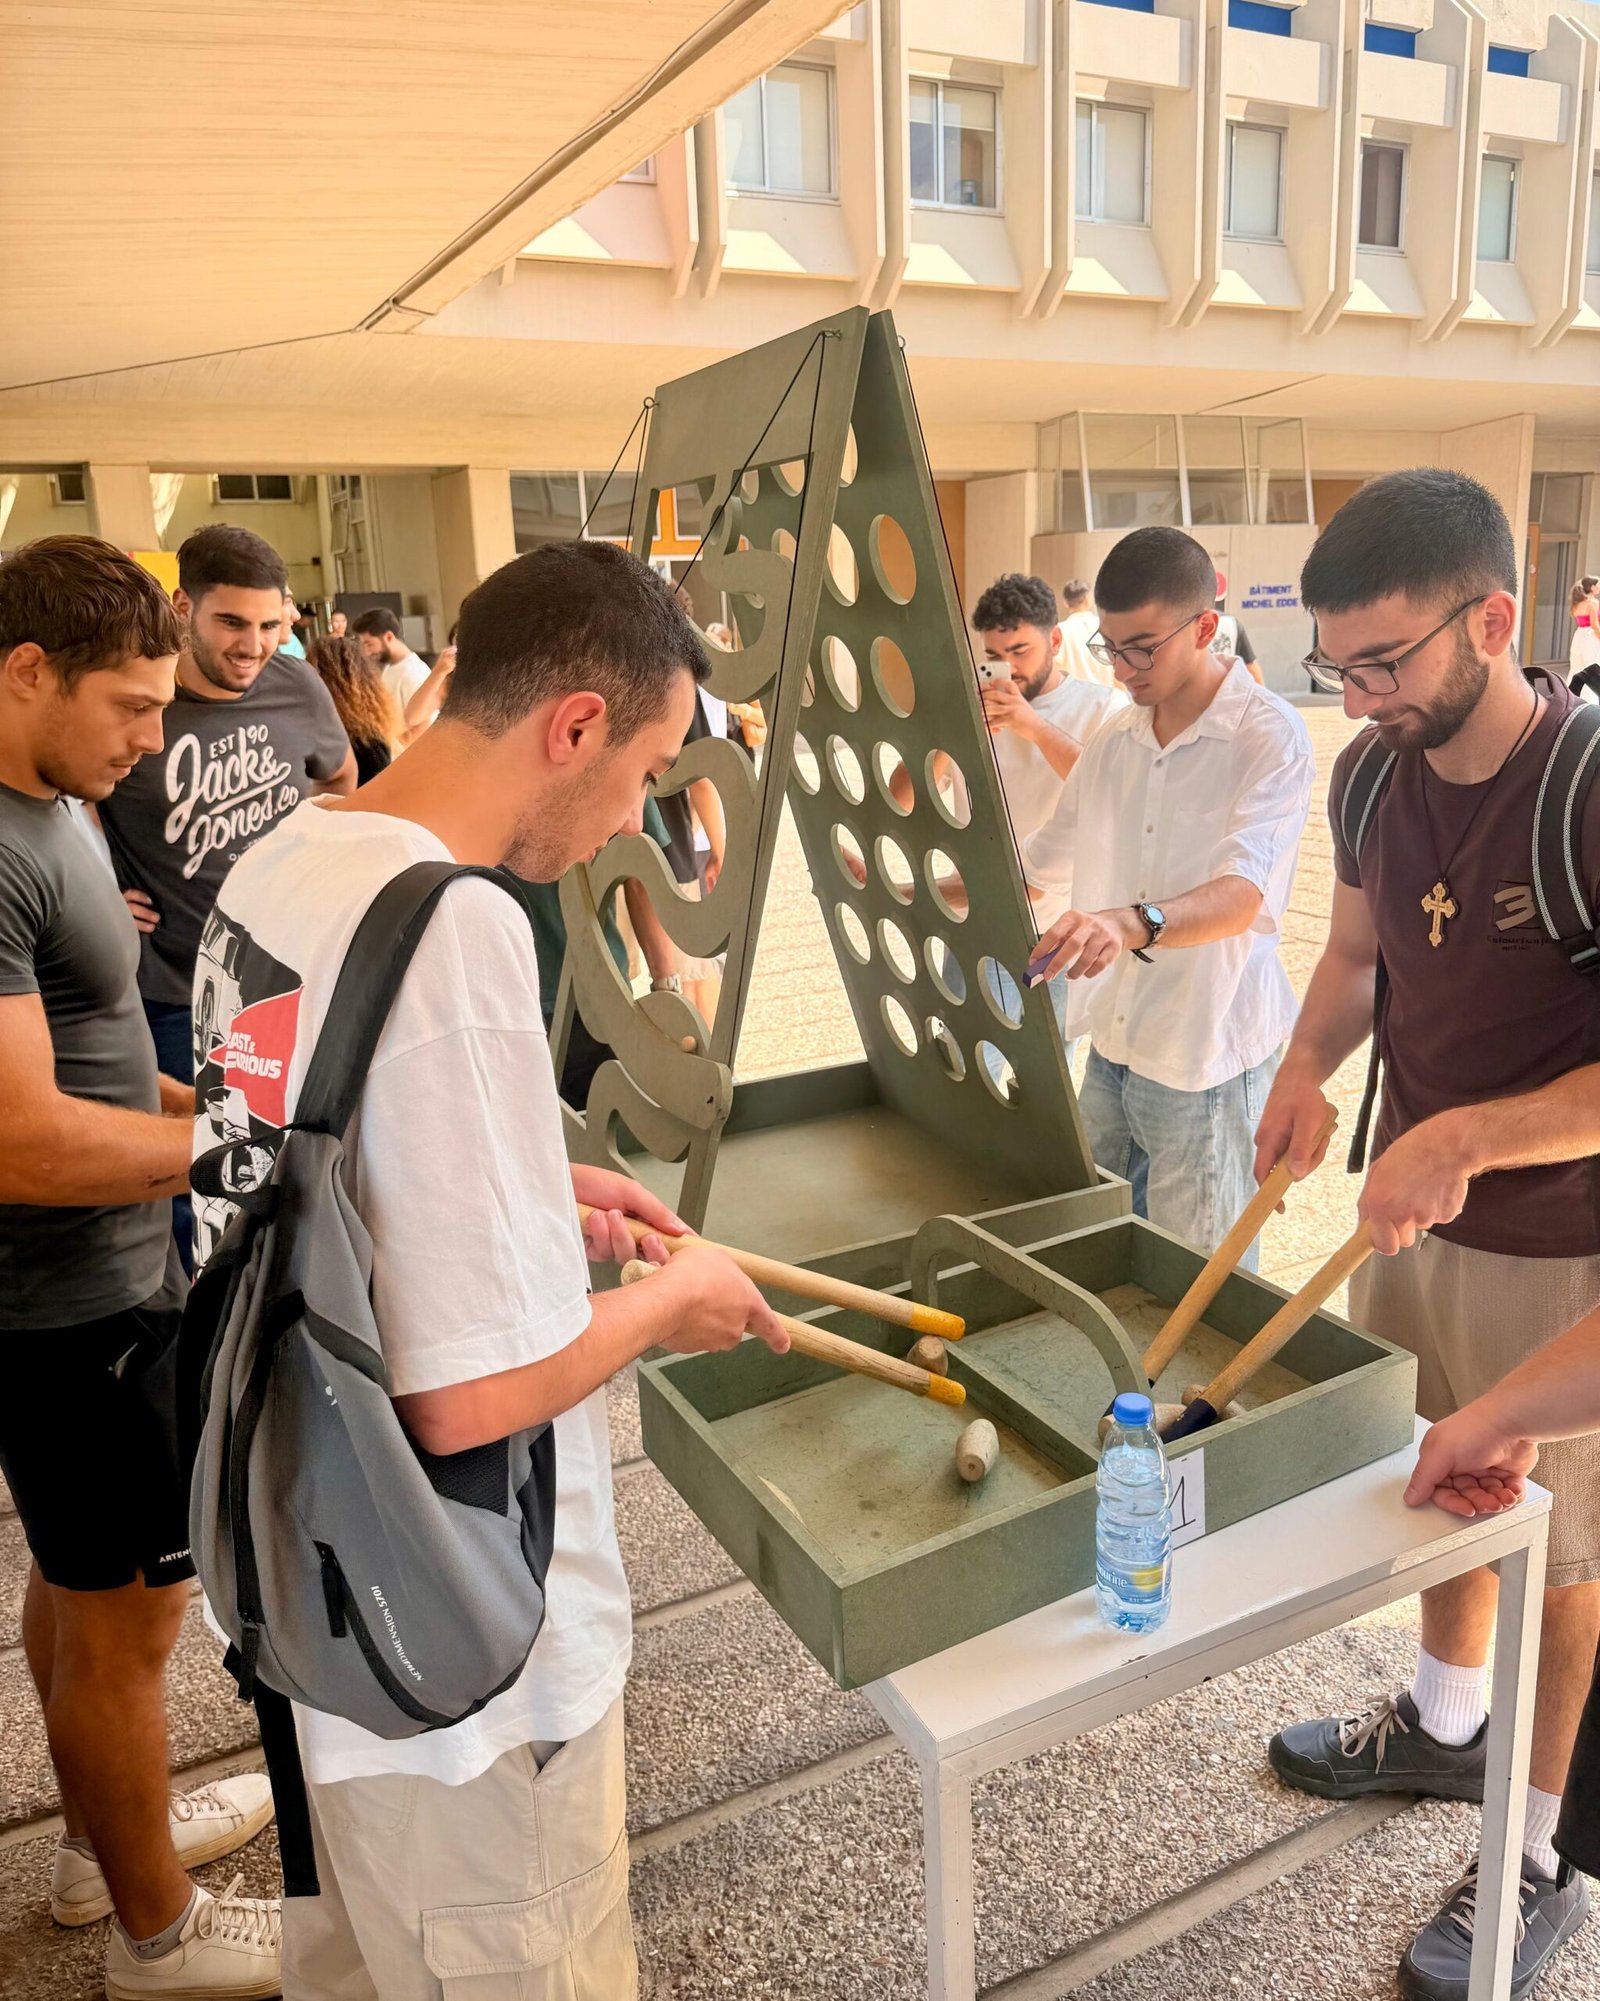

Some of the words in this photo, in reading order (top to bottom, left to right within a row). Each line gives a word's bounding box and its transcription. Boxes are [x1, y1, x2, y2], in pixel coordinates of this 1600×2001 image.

[1242, 599, 1273, 609] MICHEL
[209, 734, 235, 759] EST
[227, 1031, 252, 1052] AST
[1168, 1475, 1197, 1532] 1
[1097, 1564, 1128, 1588] ourine
[370, 1585, 388, 1607] 5701
